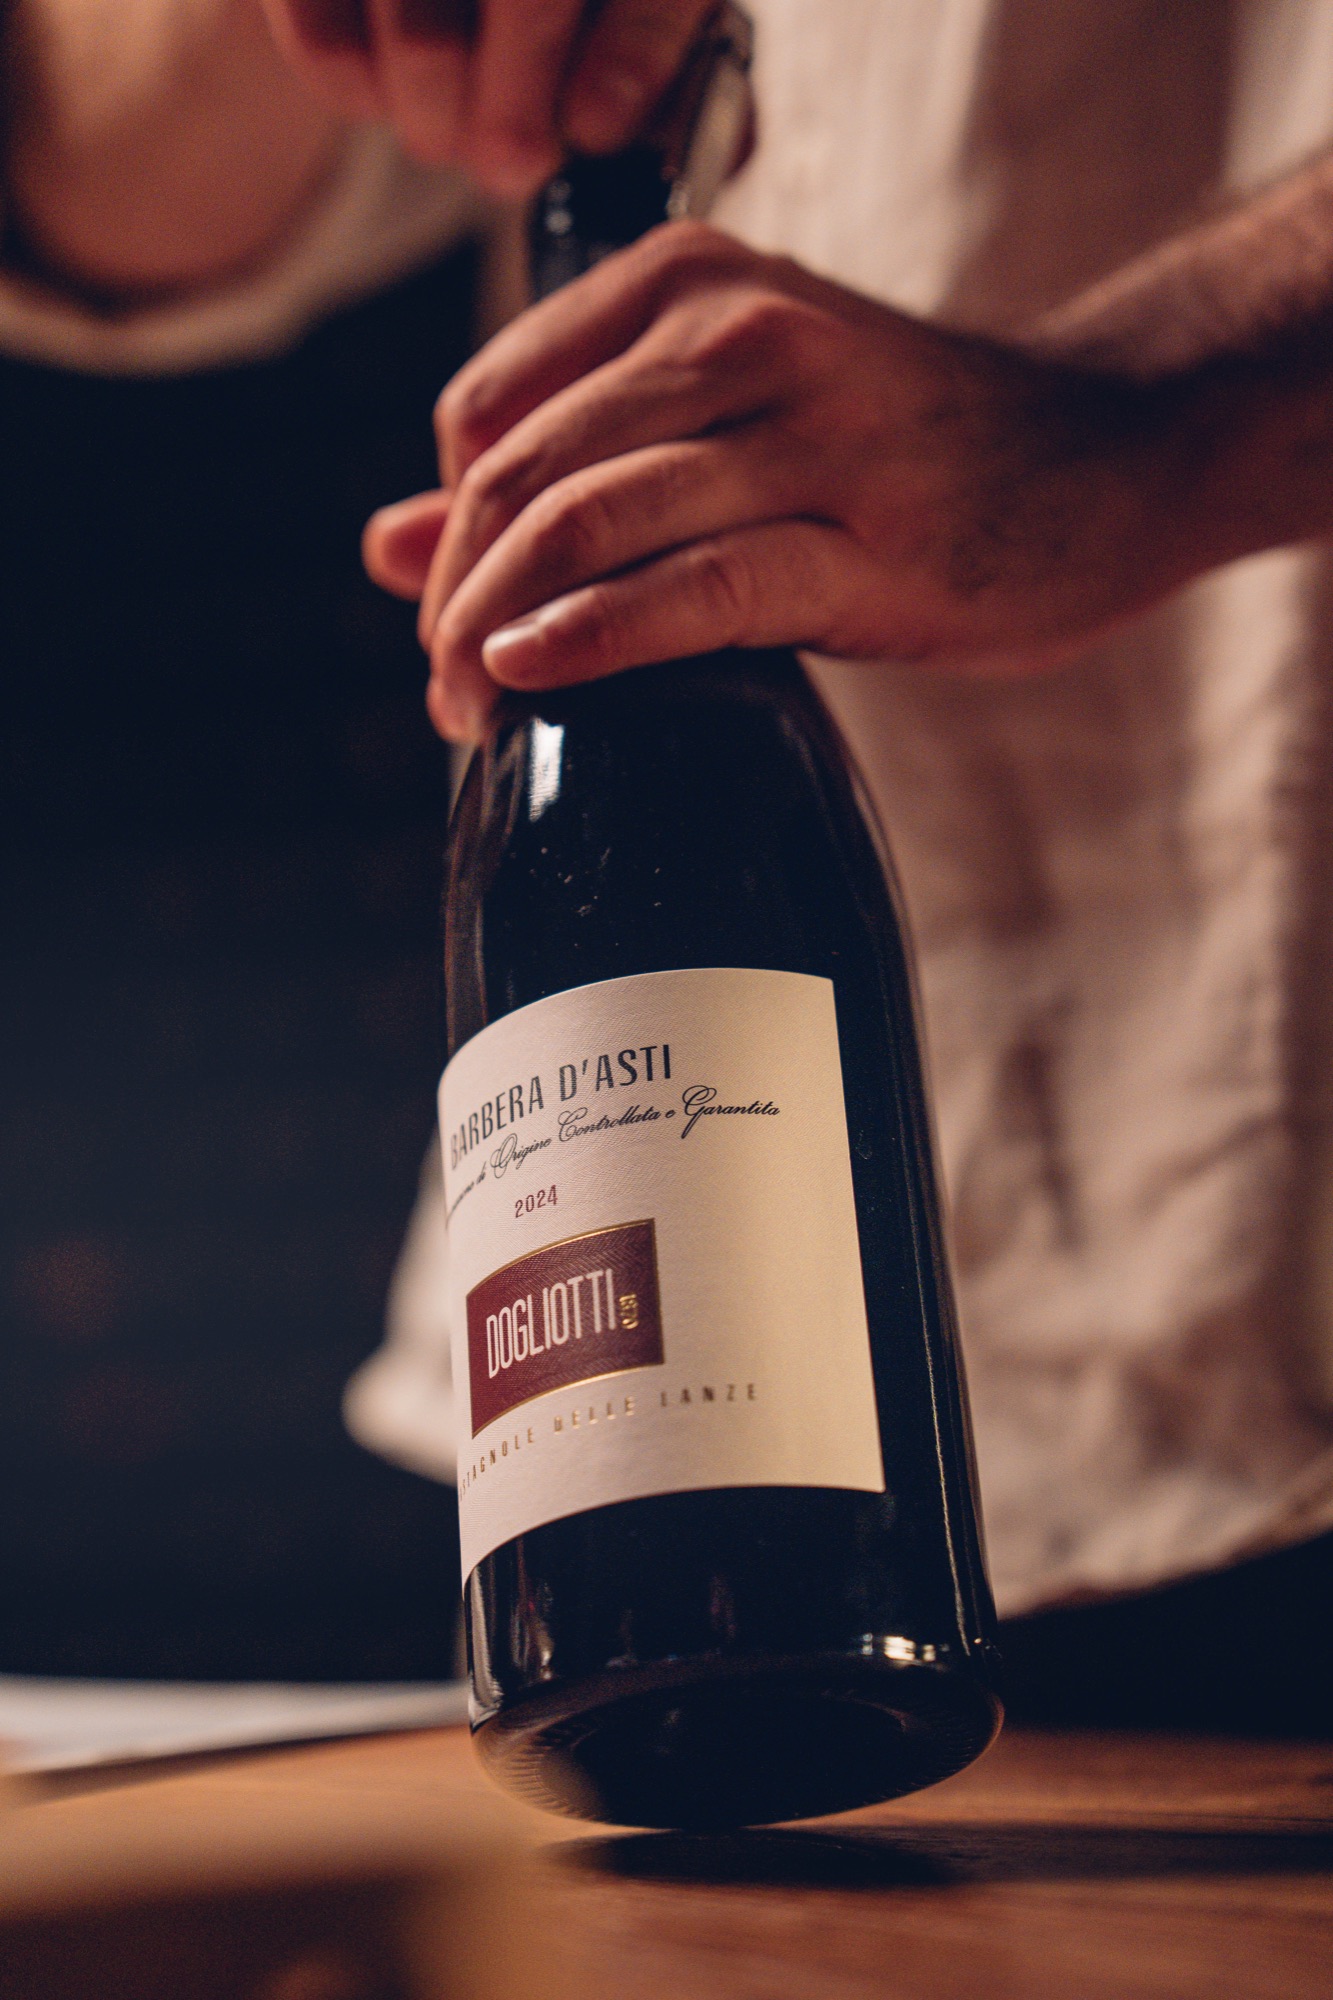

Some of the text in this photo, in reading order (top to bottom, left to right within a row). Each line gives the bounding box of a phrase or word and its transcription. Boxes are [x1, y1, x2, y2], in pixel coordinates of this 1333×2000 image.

[450, 1044, 671, 1171] BARBERA D'ASTI
[490, 1132, 553, 1179] Origine
[557, 1104, 662, 1142] Controllata
[665, 1107, 676, 1119] e
[681, 1085, 781, 1140] Garantita
[514, 1185, 558, 1219] 2024
[486, 1268, 617, 1379] DOGLIOTTI
[460, 1384, 757, 1501] STAGNOLE DELLE LANZE
